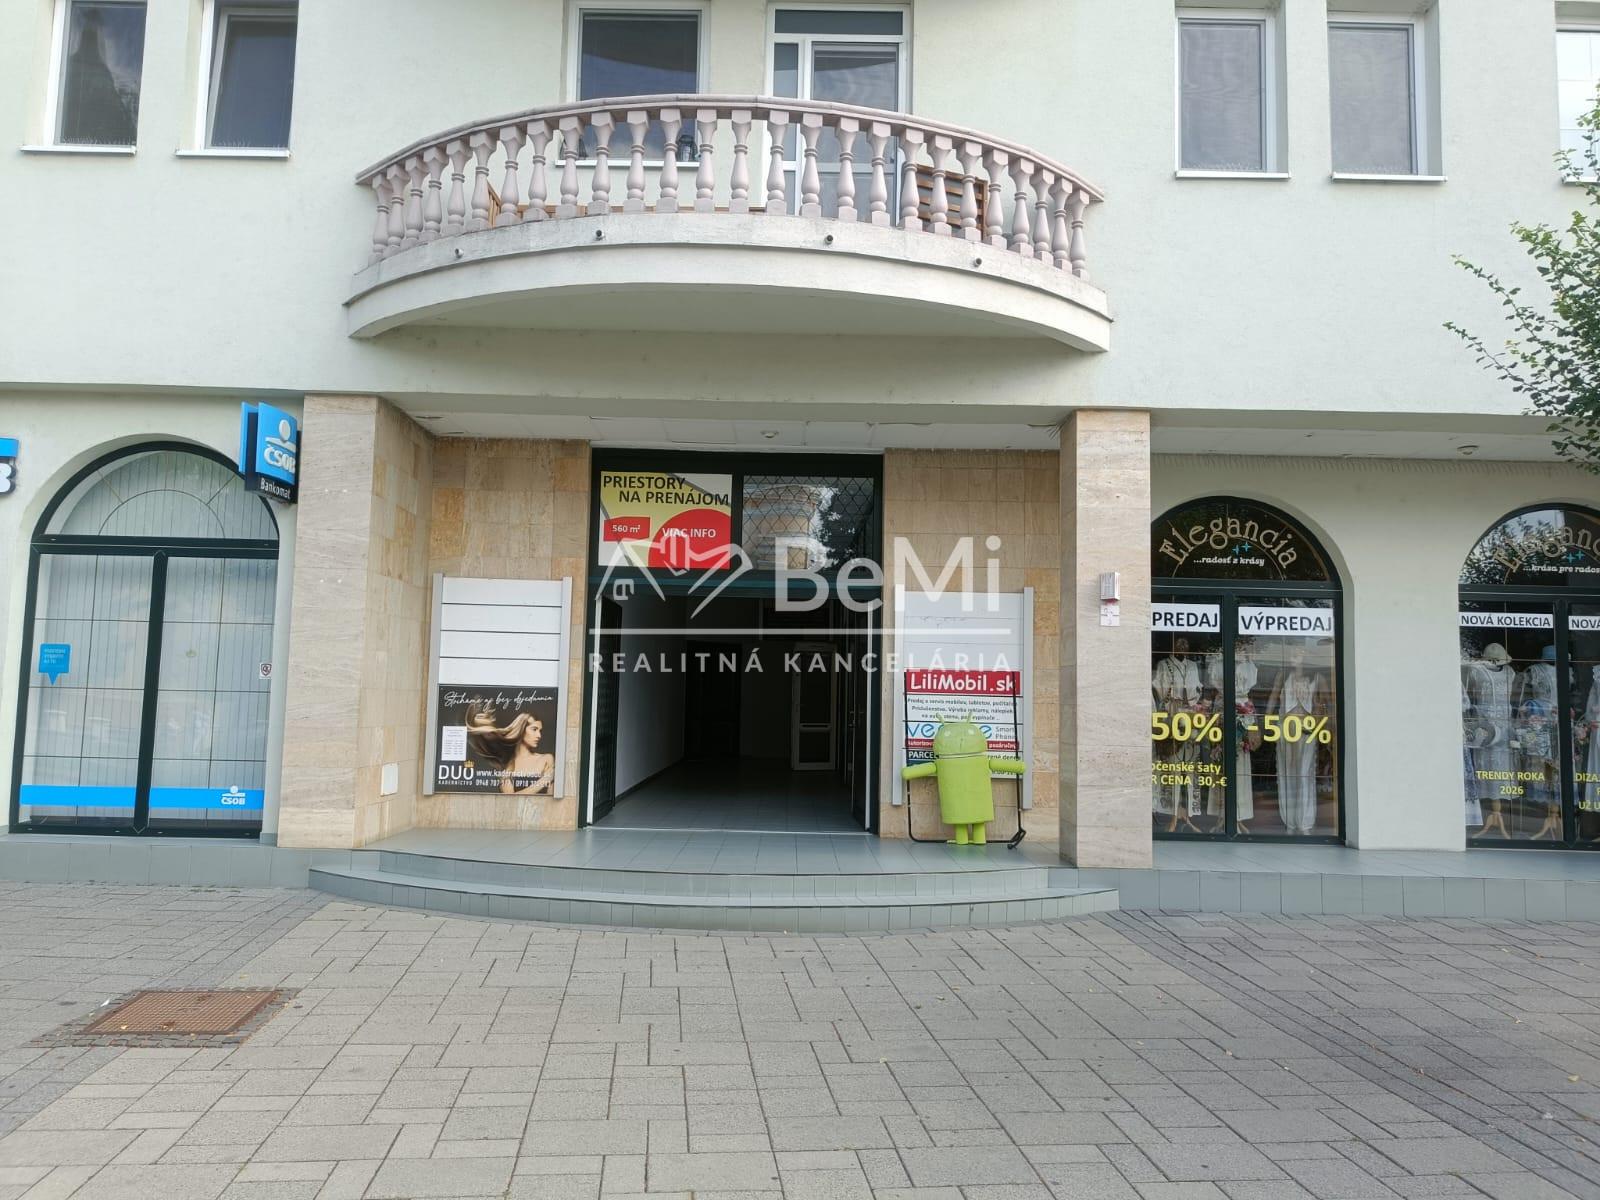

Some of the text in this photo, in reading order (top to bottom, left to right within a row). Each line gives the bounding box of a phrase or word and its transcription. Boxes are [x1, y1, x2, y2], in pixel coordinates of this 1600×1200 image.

[264, 444, 296, 474] ČSOB
[260, 478, 291, 499] Bankomat
[603, 475, 685, 490] PRIESTORY
[619, 488, 729, 506] NA PRENÁJOM
[612, 524, 628, 533] 560
[662, 527, 717, 538] VIAC INFO
[1159, 517, 1297, 568] Elegancia
[1239, 556, 1265, 567] krásy
[1240, 611, 1333, 632] VÝPREDAJ
[1461, 614, 1551, 627] NOVÁ KOLEKCIA
[438, 765, 474, 780] DUO
[1197, 761, 1222, 775] šaty
[1160, 775, 1192, 785] CENA
[1198, 776, 1228, 788] 30,-€
[1475, 770, 1545, 781] TRENDY ROKA
[1575, 772, 1600, 782] DIZA
[1500, 785, 1524, 795] 2026
